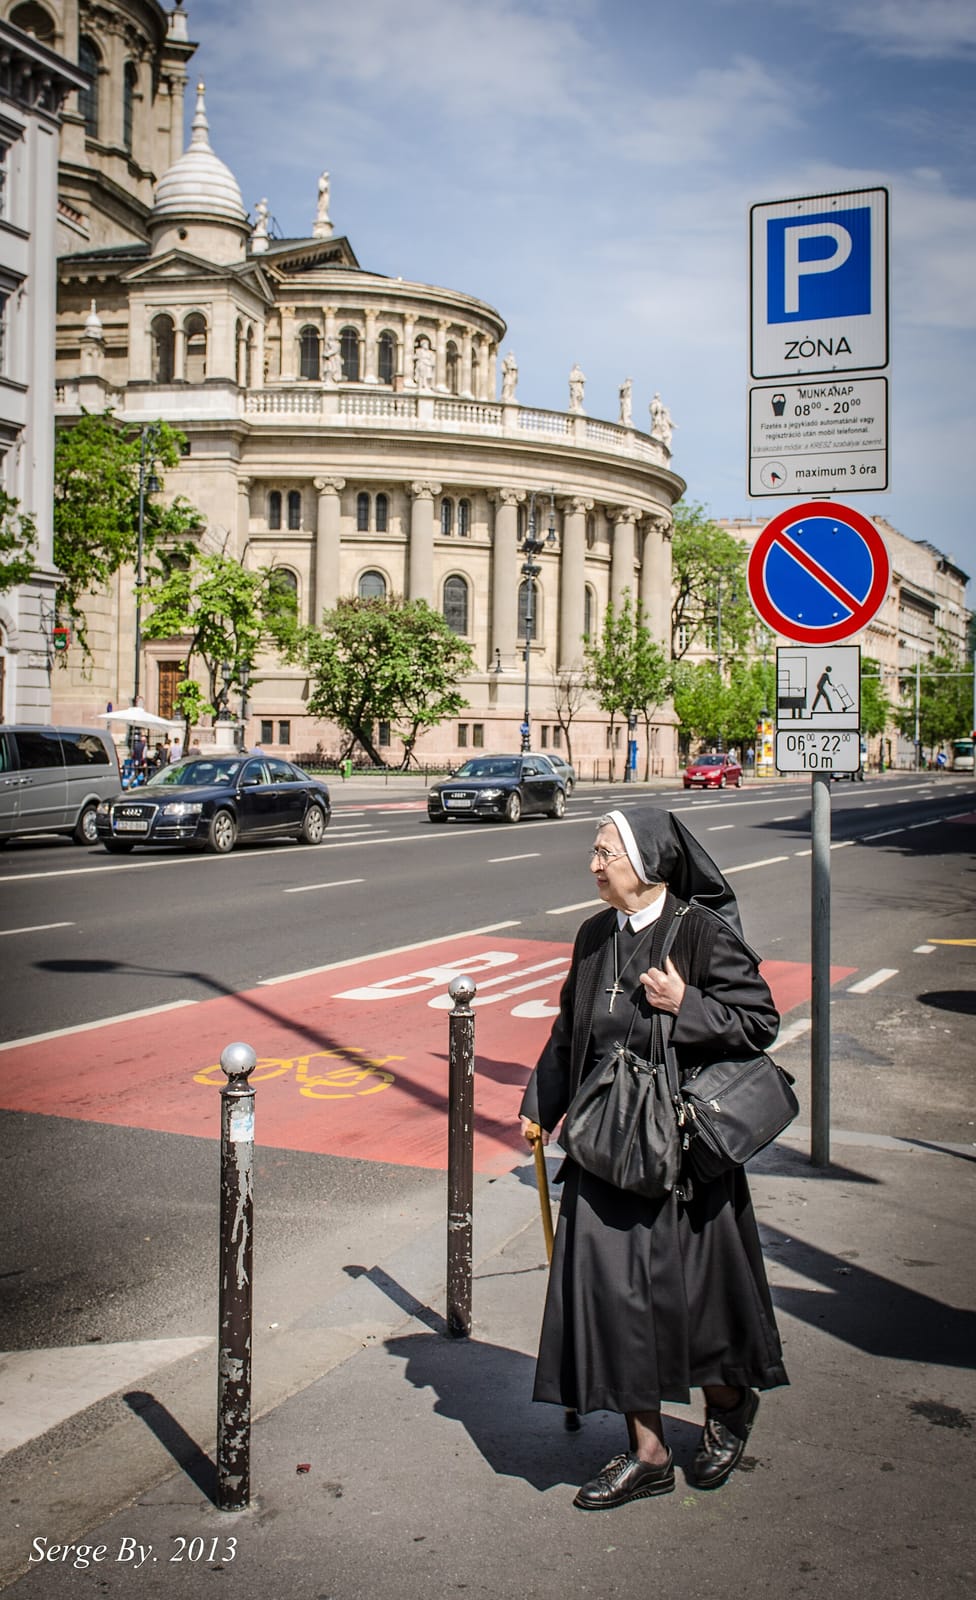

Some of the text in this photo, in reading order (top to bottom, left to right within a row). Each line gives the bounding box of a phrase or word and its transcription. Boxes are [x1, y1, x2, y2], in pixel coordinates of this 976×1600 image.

[784, 222, 852, 314] P
[799, 386, 854, 400] MUNKANAP
[860, 416, 875, 425] vagy
[818, 427, 836, 436] mobil
[795, 463, 877, 478] maximum 3 óra
[801, 752, 833, 769] 10 m
